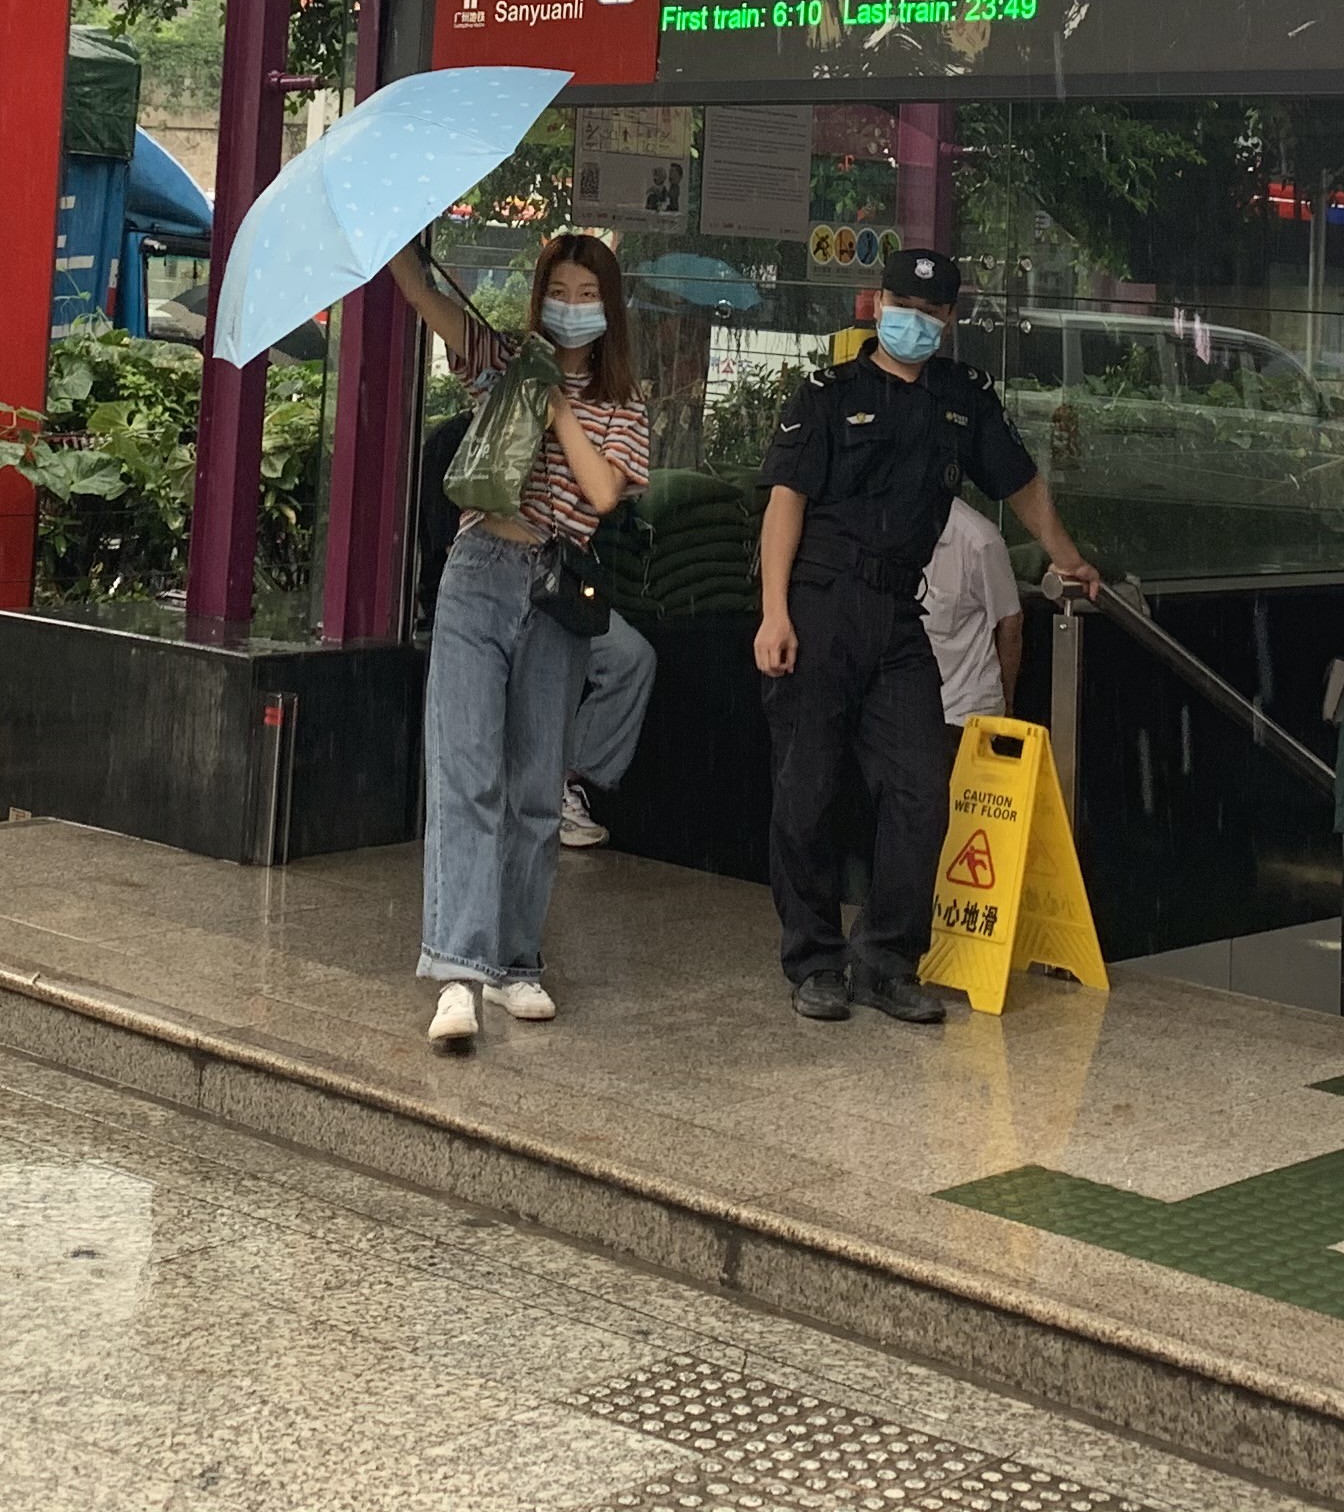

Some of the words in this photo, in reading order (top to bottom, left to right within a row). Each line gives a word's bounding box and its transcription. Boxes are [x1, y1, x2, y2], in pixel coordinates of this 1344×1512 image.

[662, 6, 707, 31] First
[713, 2, 765, 29] train:
[772, 0, 822, 26] 6:10
[963, 788, 1013, 808] CAUTION
[955, 799, 978, 814] WET
[980, 802, 1018, 822] FLOOR
